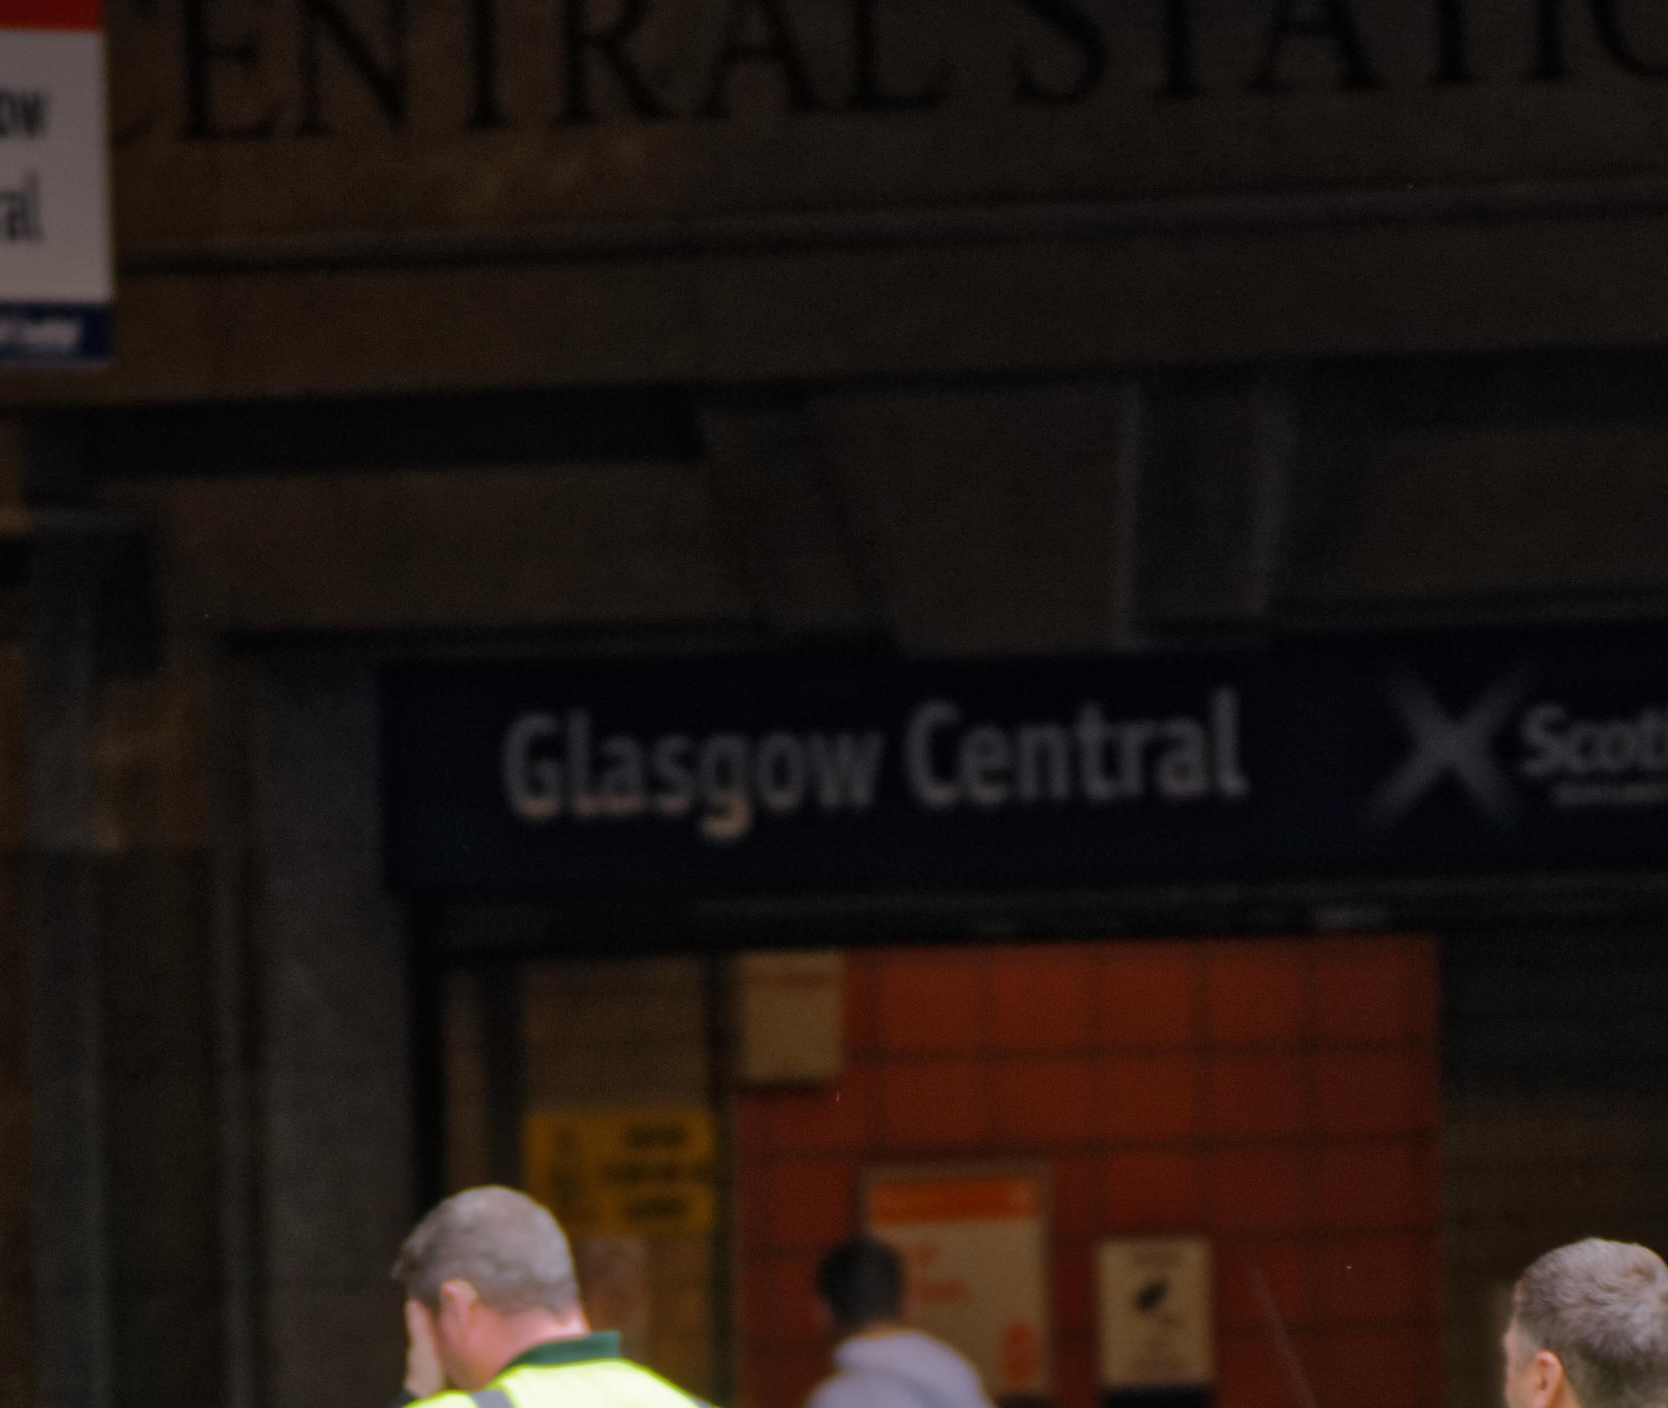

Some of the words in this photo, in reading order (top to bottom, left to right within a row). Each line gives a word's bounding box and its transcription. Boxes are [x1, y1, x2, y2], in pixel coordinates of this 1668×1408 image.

[114, 0, 951, 146] ENTRAL
[499, 703, 887, 846] Glasgow
[902, 684, 1250, 805] Central
